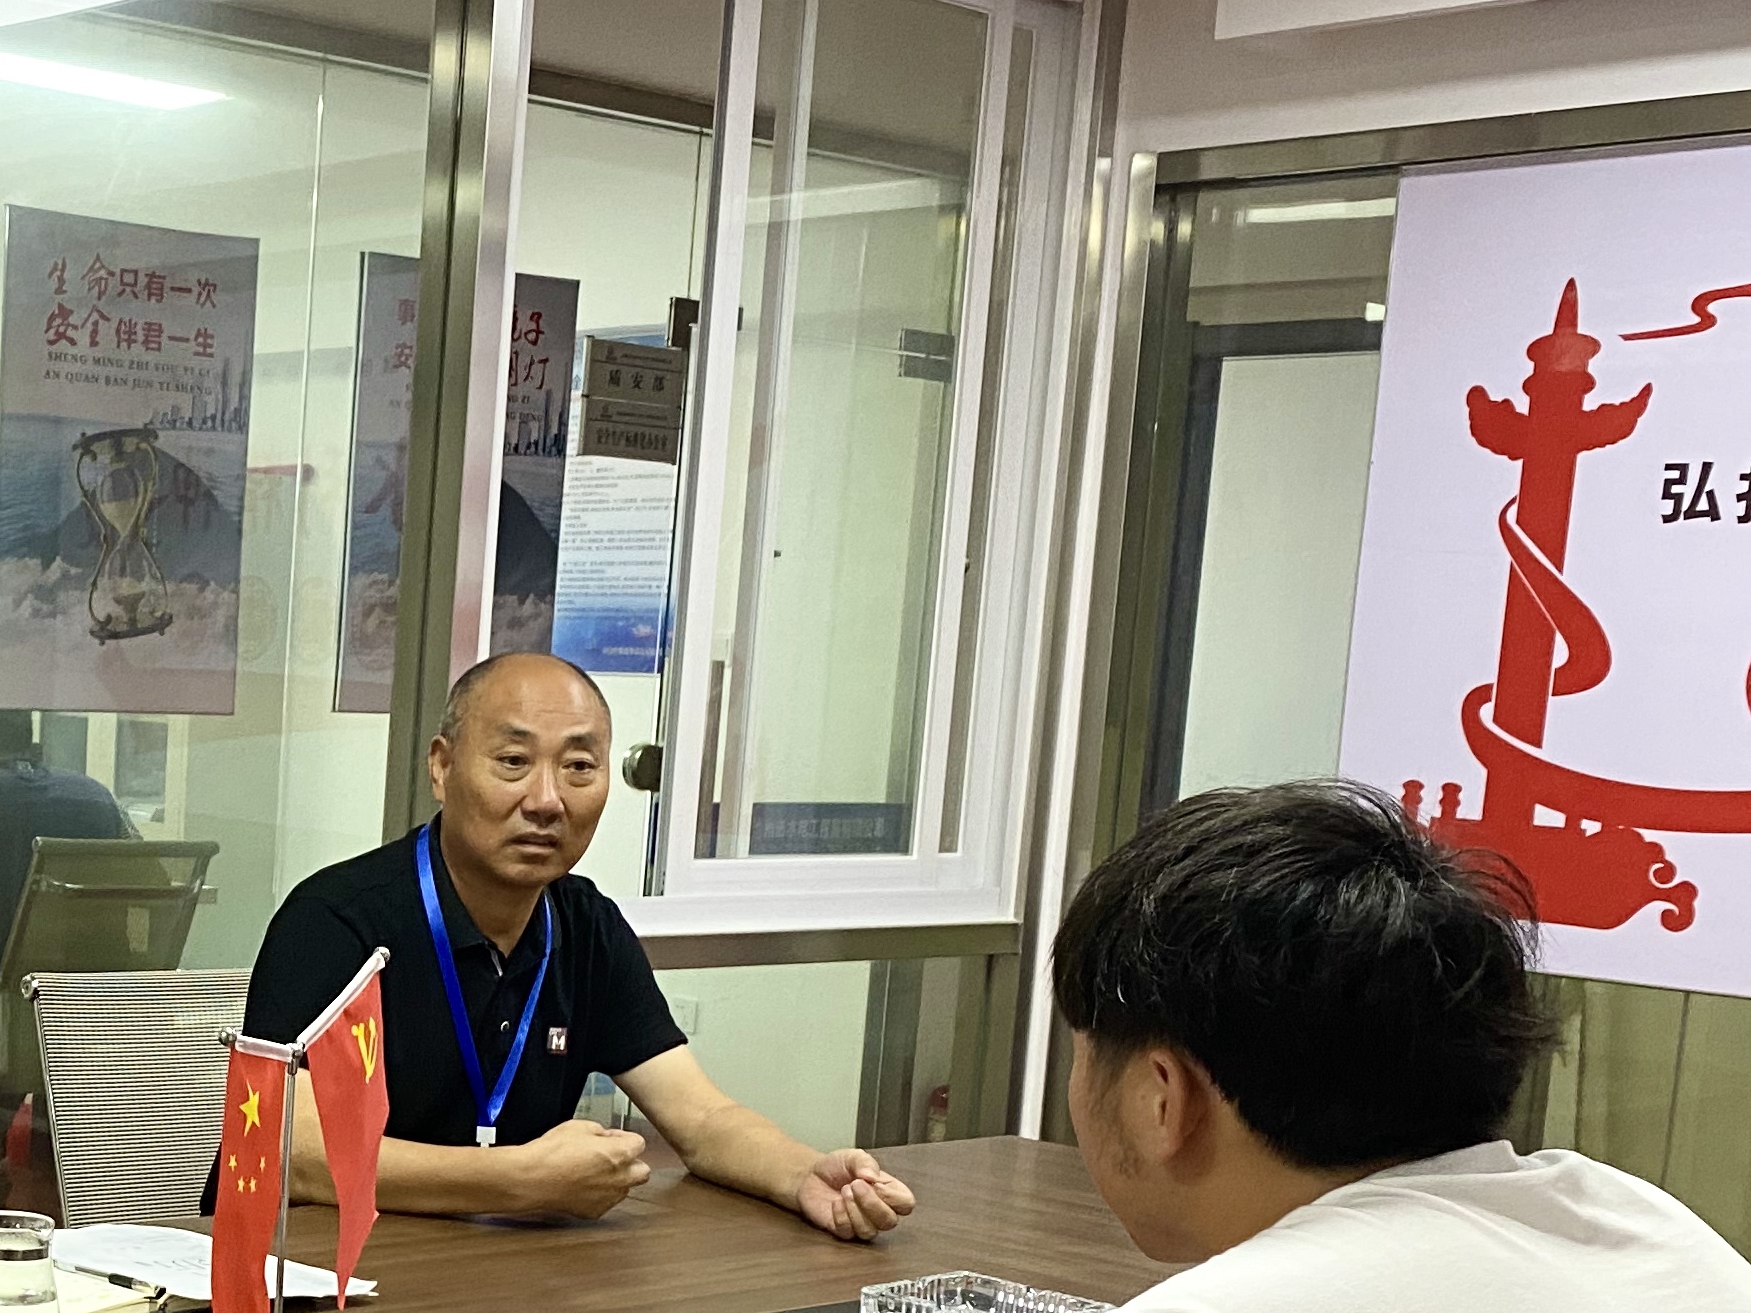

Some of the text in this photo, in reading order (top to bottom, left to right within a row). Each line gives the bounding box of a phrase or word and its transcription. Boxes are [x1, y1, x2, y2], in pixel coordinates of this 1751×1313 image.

[48, 253, 217, 309] 生命只有一次
[45, 301, 215, 358] 安全伴君一生
[1661, 461, 1751, 524] 弘
